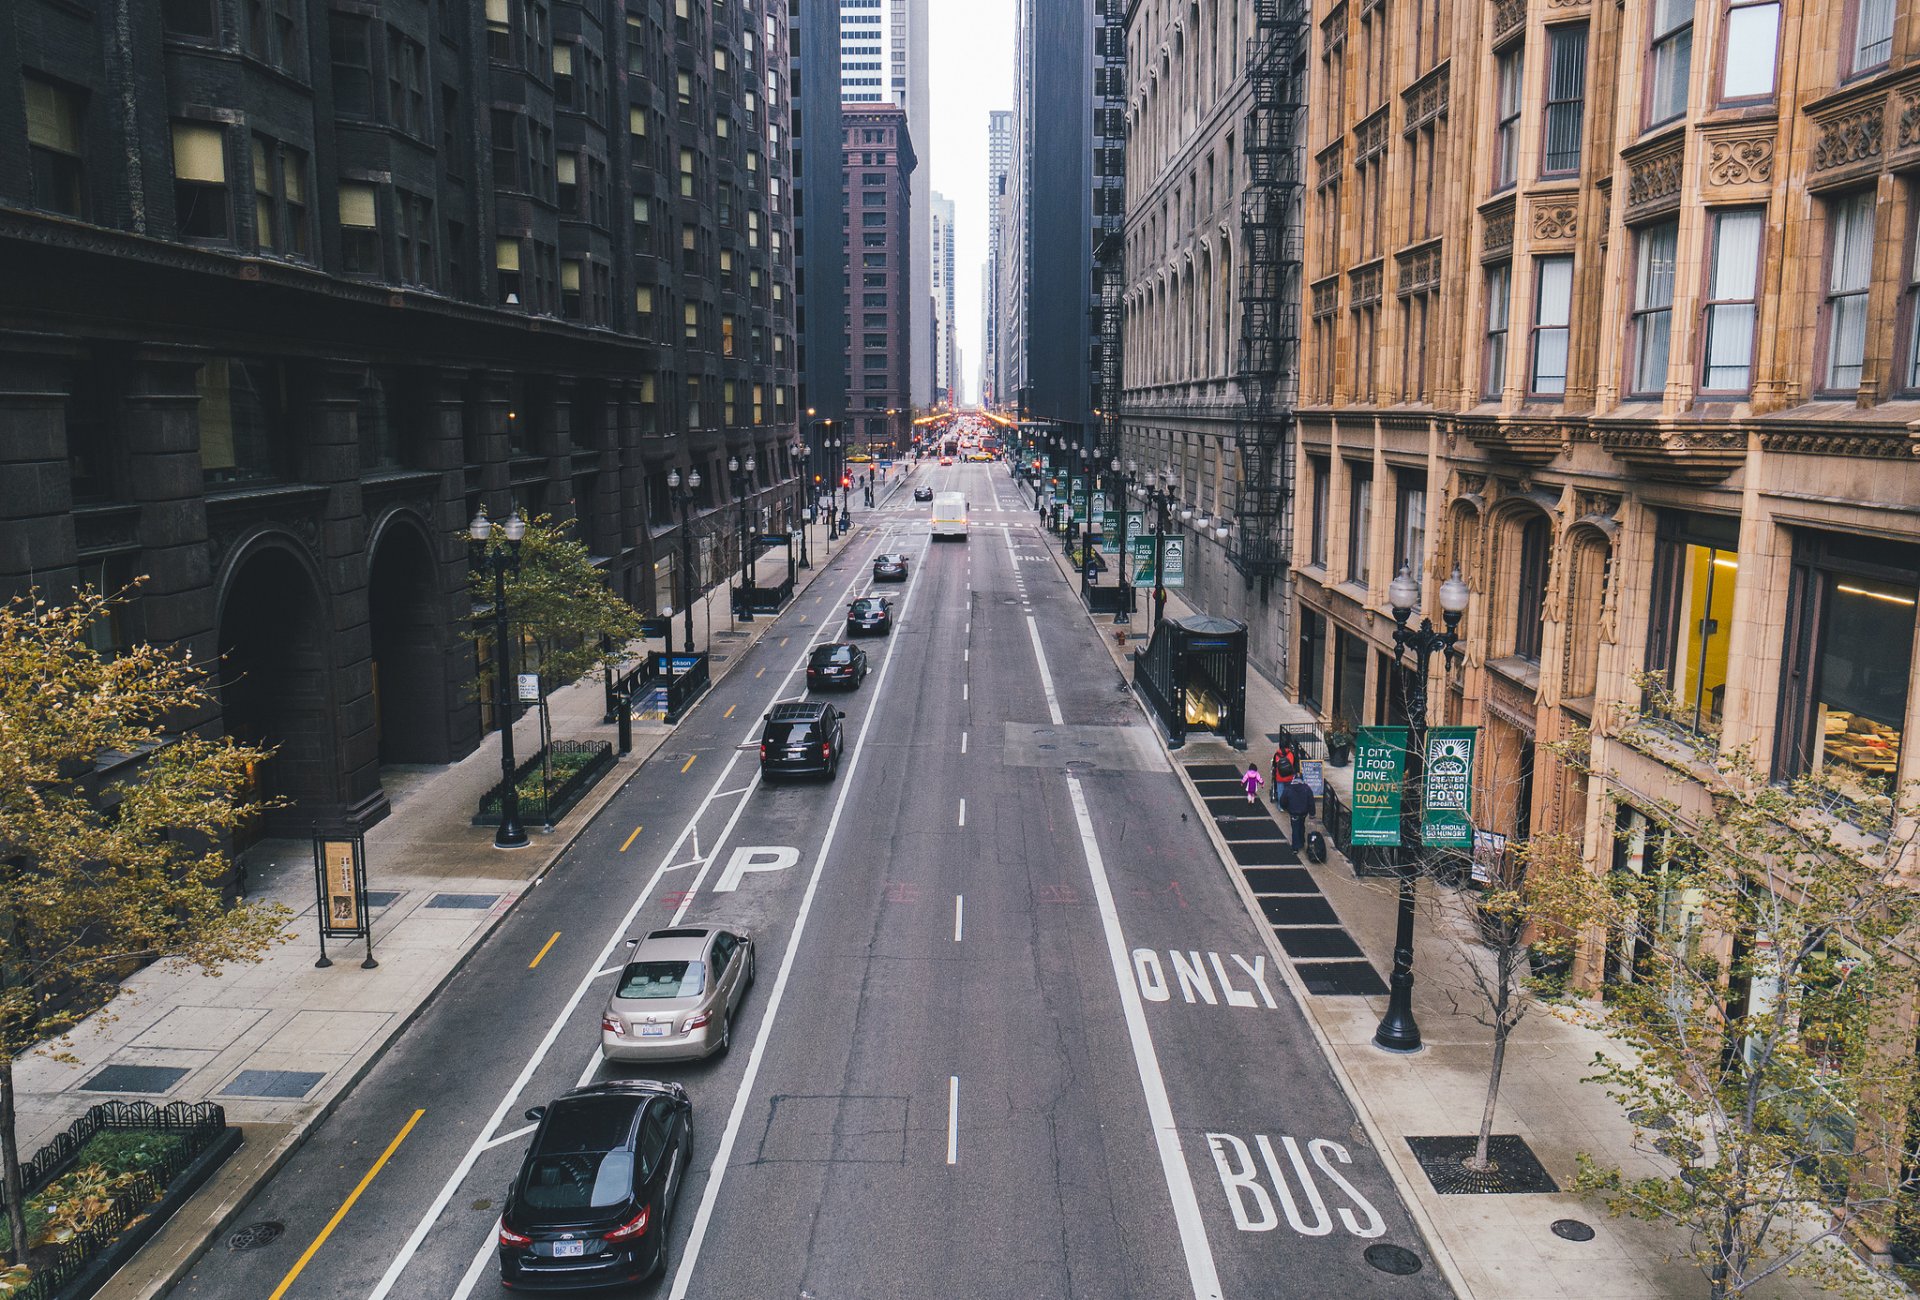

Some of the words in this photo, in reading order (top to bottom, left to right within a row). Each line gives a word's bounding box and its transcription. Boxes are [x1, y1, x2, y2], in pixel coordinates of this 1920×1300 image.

[1359, 747, 1364, 757] 1
[1358, 758, 1363, 768] 1
[1366, 760, 1395, 769] FOOD
[1356, 771, 1389, 780] DRIVE.
[1356, 783, 1398, 793] DONATE
[1356, 794, 1389, 804] TODAY.
[1430, 790, 1464, 801] FOOD
[712, 846, 800, 892] P
[1132, 948, 1278, 1009] ONLY
[1206, 1132, 1387, 1238] BUS
